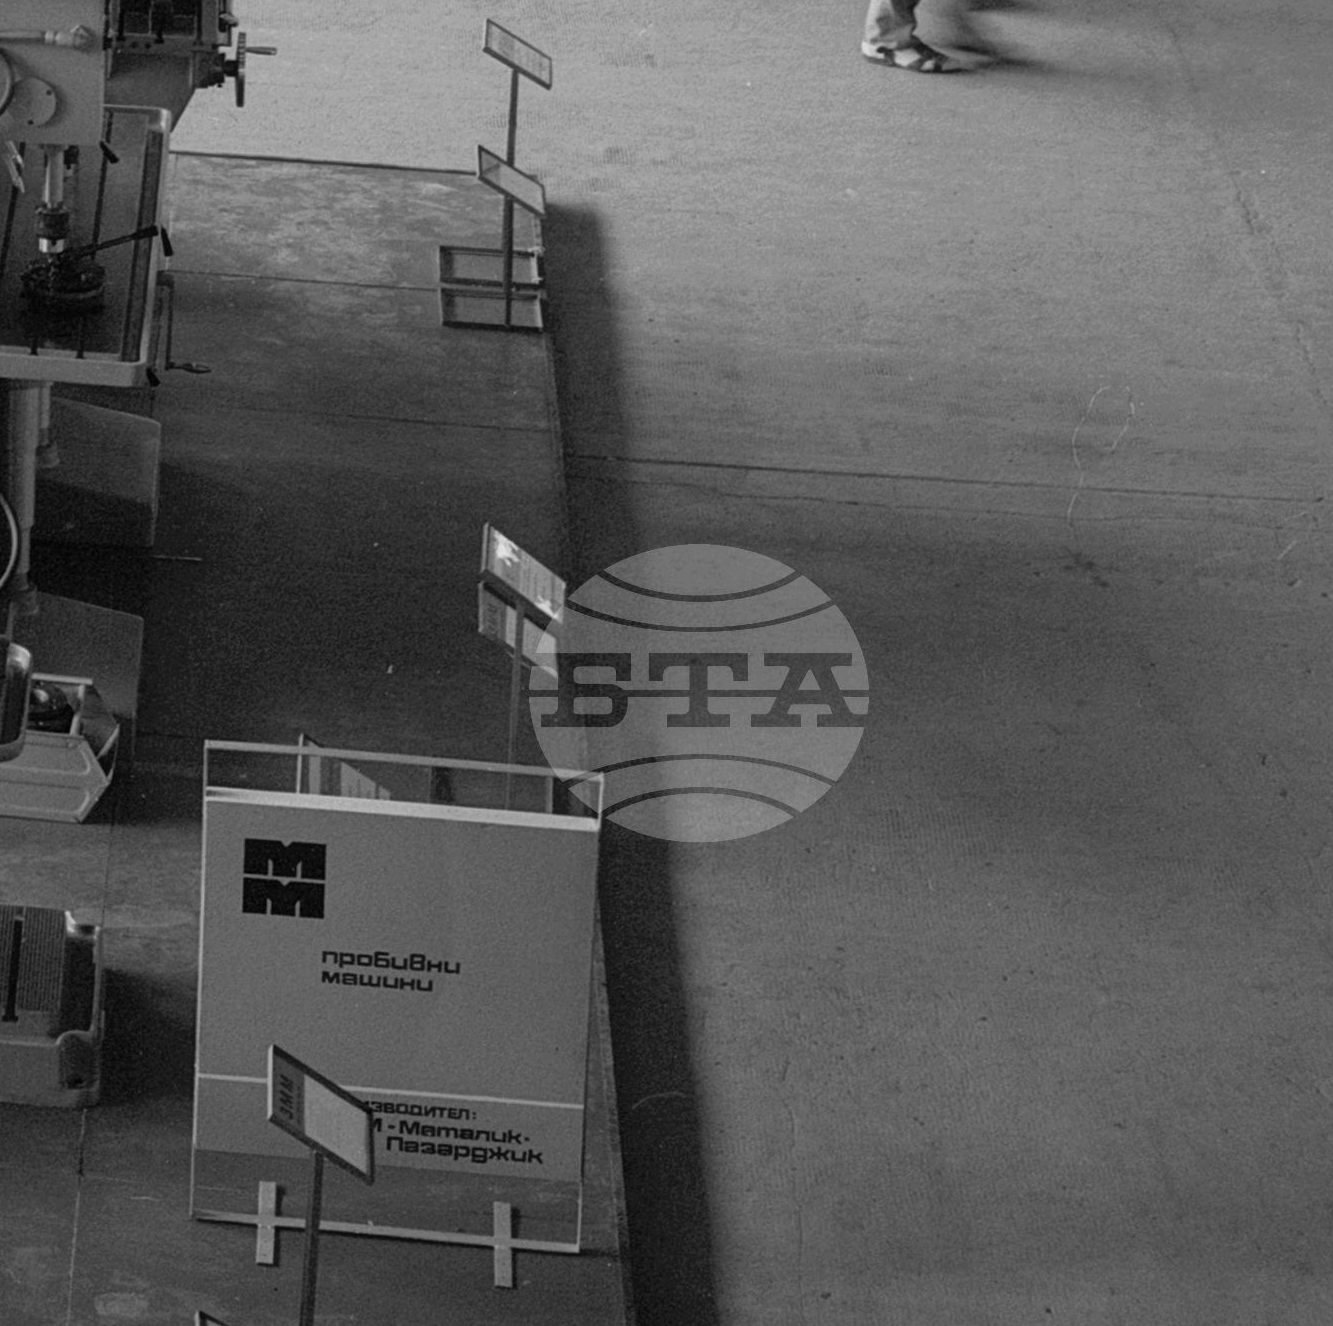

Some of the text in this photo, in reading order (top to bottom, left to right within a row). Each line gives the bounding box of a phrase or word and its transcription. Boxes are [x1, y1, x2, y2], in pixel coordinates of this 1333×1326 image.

[322, 950, 461, 974] пробивни
[321, 970, 433, 992] машини
[365, 1101, 476, 1120] ЗВОДИТЕЛ:
[386, 1136, 543, 1164] Пазарджик
